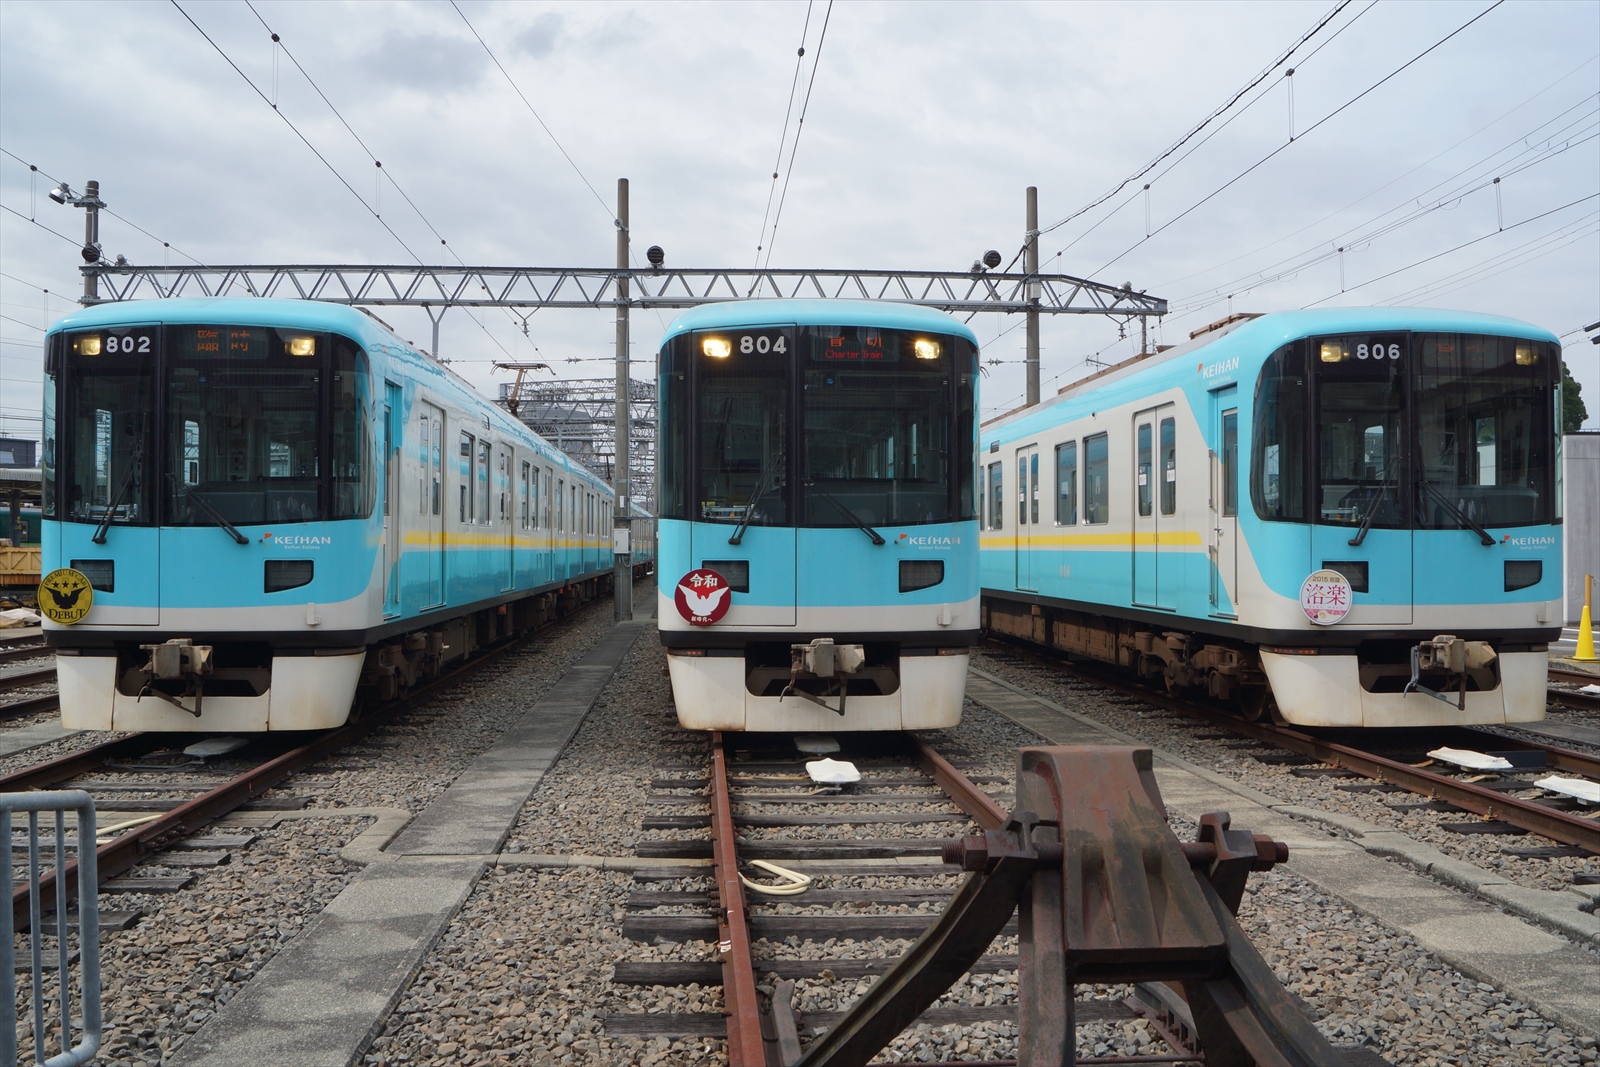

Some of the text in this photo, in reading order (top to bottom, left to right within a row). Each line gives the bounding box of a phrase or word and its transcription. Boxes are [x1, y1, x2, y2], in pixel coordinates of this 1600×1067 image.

[106, 336, 151, 353] 802
[740, 336, 787, 354] 804
[1356, 343, 1400, 360] 806
[825, 350, 883, 359] Charter Train
[1203, 356, 1239, 379] KEIHAN
[274, 535, 331, 544] KEIHAN
[909, 536, 961, 545] KEIHAN
[1512, 536, 1555, 545] KEIHAN
[690, 573, 718, 588] 令和
[1306, 584, 1346, 606] 洛楽
[48, 608, 86, 620] DEBUT
